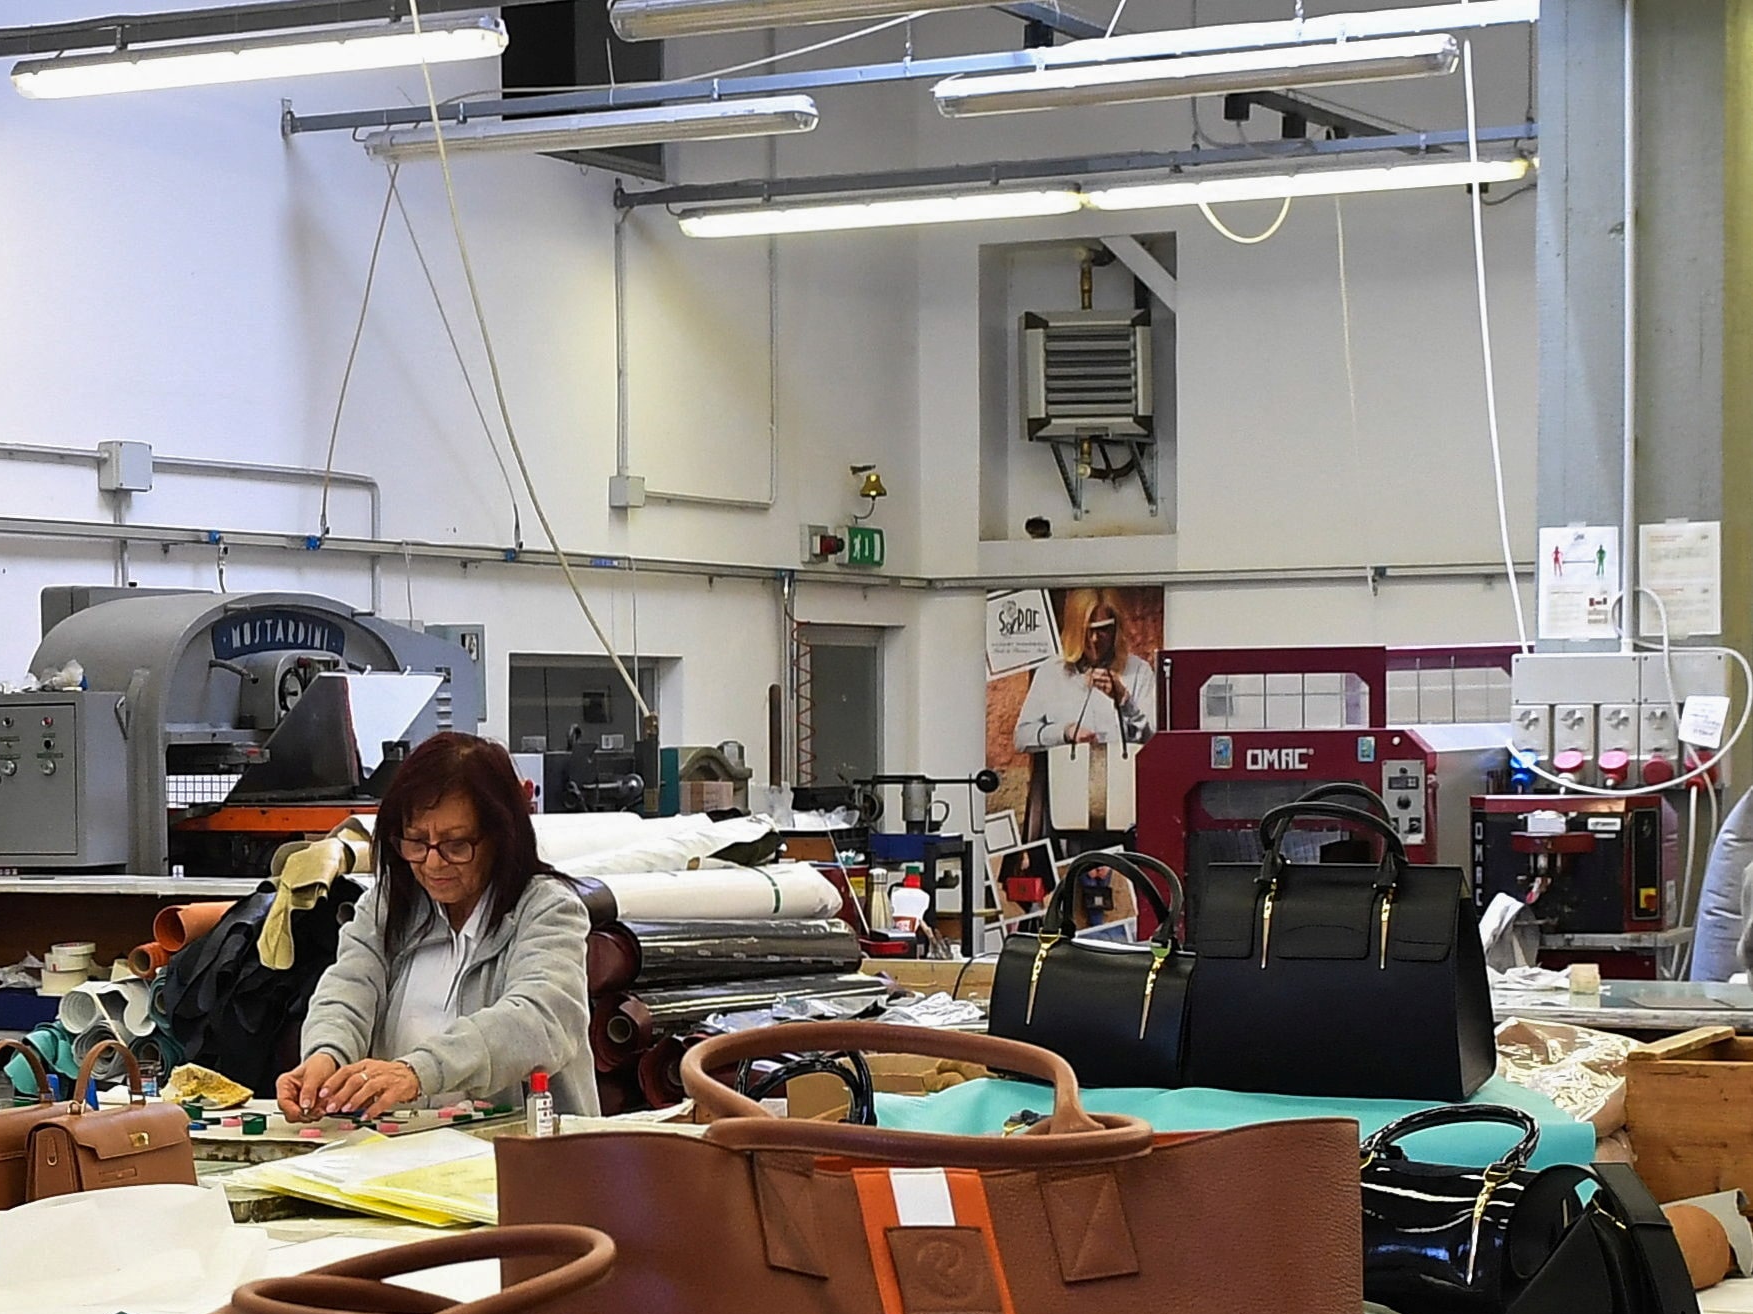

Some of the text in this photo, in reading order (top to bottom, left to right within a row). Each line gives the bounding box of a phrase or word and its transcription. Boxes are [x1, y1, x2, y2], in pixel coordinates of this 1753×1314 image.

[231, 619, 329, 651] MOSTARDINI
[1246, 748, 1309, 770] OMAC
[1474, 821, 1483, 907] OMAC
